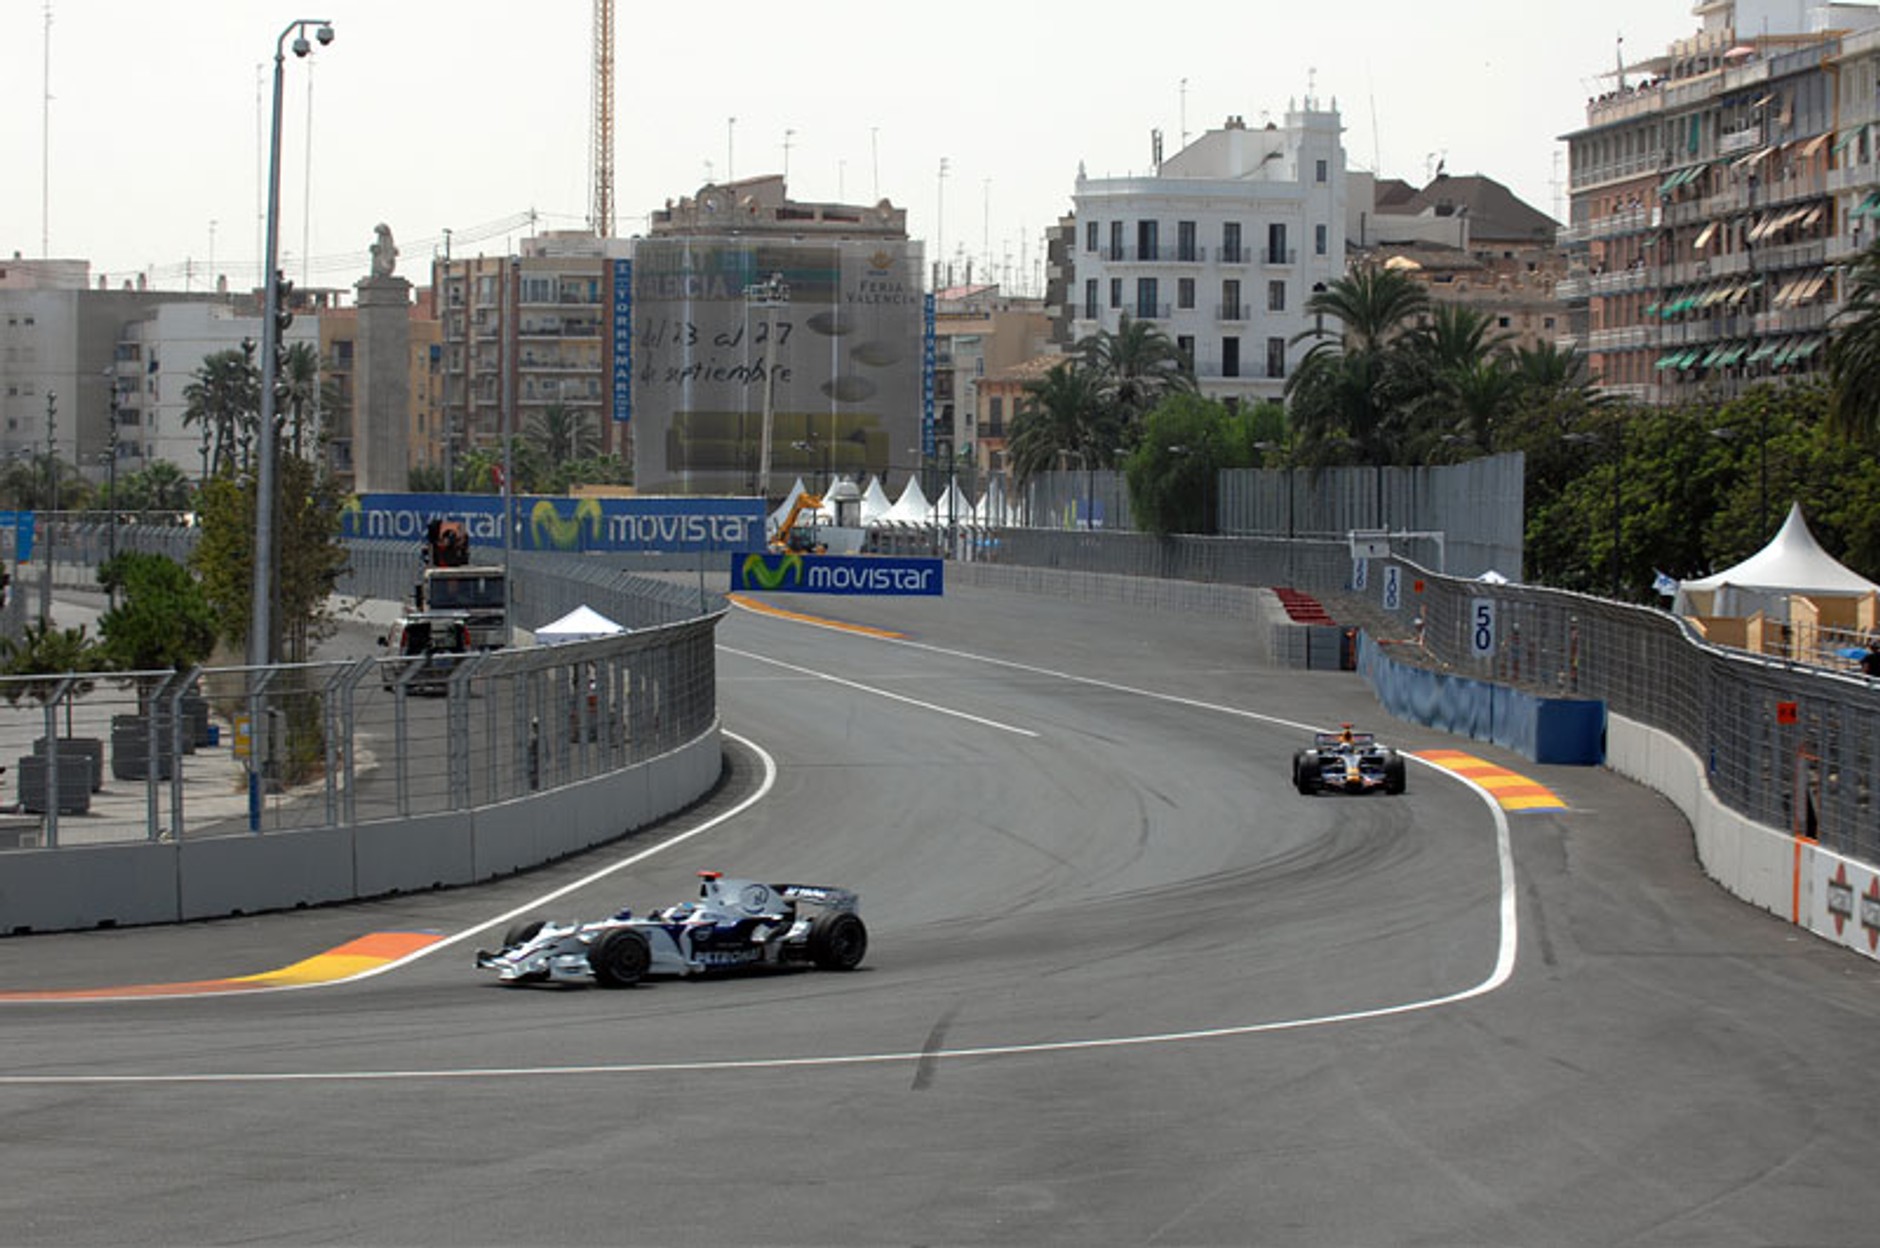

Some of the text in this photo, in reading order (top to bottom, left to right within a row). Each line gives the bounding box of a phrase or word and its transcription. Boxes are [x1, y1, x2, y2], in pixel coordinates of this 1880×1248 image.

[713, 323, 745, 347] al
[754, 321, 793, 345] 27
[609, 514, 758, 543] movistar
[808, 565, 934, 590] movistar
[1386, 568, 1398, 608] 100
[1475, 606, 1492, 651] 50
